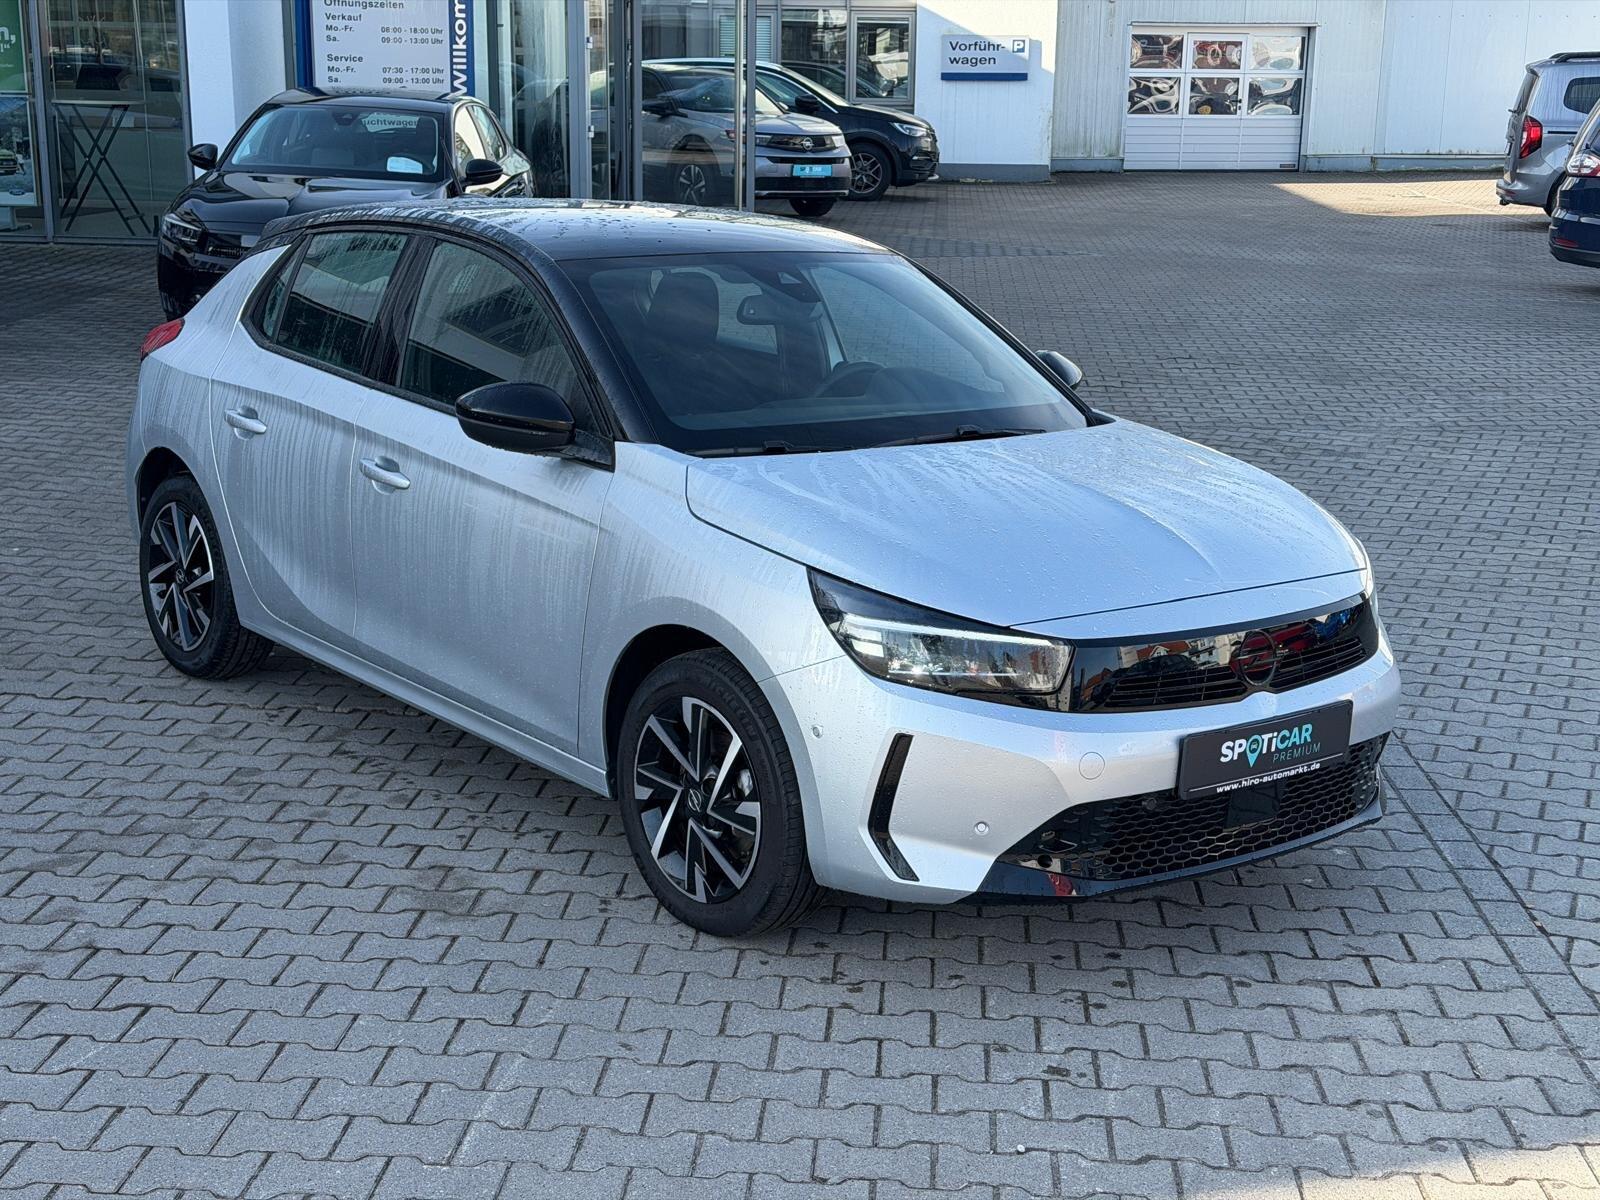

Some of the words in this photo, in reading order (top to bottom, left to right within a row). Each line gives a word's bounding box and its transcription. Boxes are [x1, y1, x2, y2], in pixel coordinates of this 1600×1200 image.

[325, 12, 362, 21] Verkauf
[325, 24, 355, 32] Mo.-Fr.
[430, 27, 444, 35] Uhr
[325, 34, 340, 42] Sa.
[381, 36, 403, 44] 09:00
[409, 37, 430, 45] 13:00
[430, 37, 444, 45] Uhr
[949, 40, 1006, 52] Vorführ-
[327, 53, 364, 63] Service
[949, 55, 996, 67] wagen
[327, 65, 357, 73] Mo.-Fr.
[382, 66, 404, 74] 07:30
[431, 67, 445, 75] Uhr
[327, 75, 342, 83] Sa.
[382, 76, 404, 84] 09:00
[410, 77, 431, 85] 13:00
[431, 77, 445, 85] Uhr
[1272, 742, 1322, 764] PREMIUM
[1216, 761, 1321, 793] www.hiro-automarkt.de
